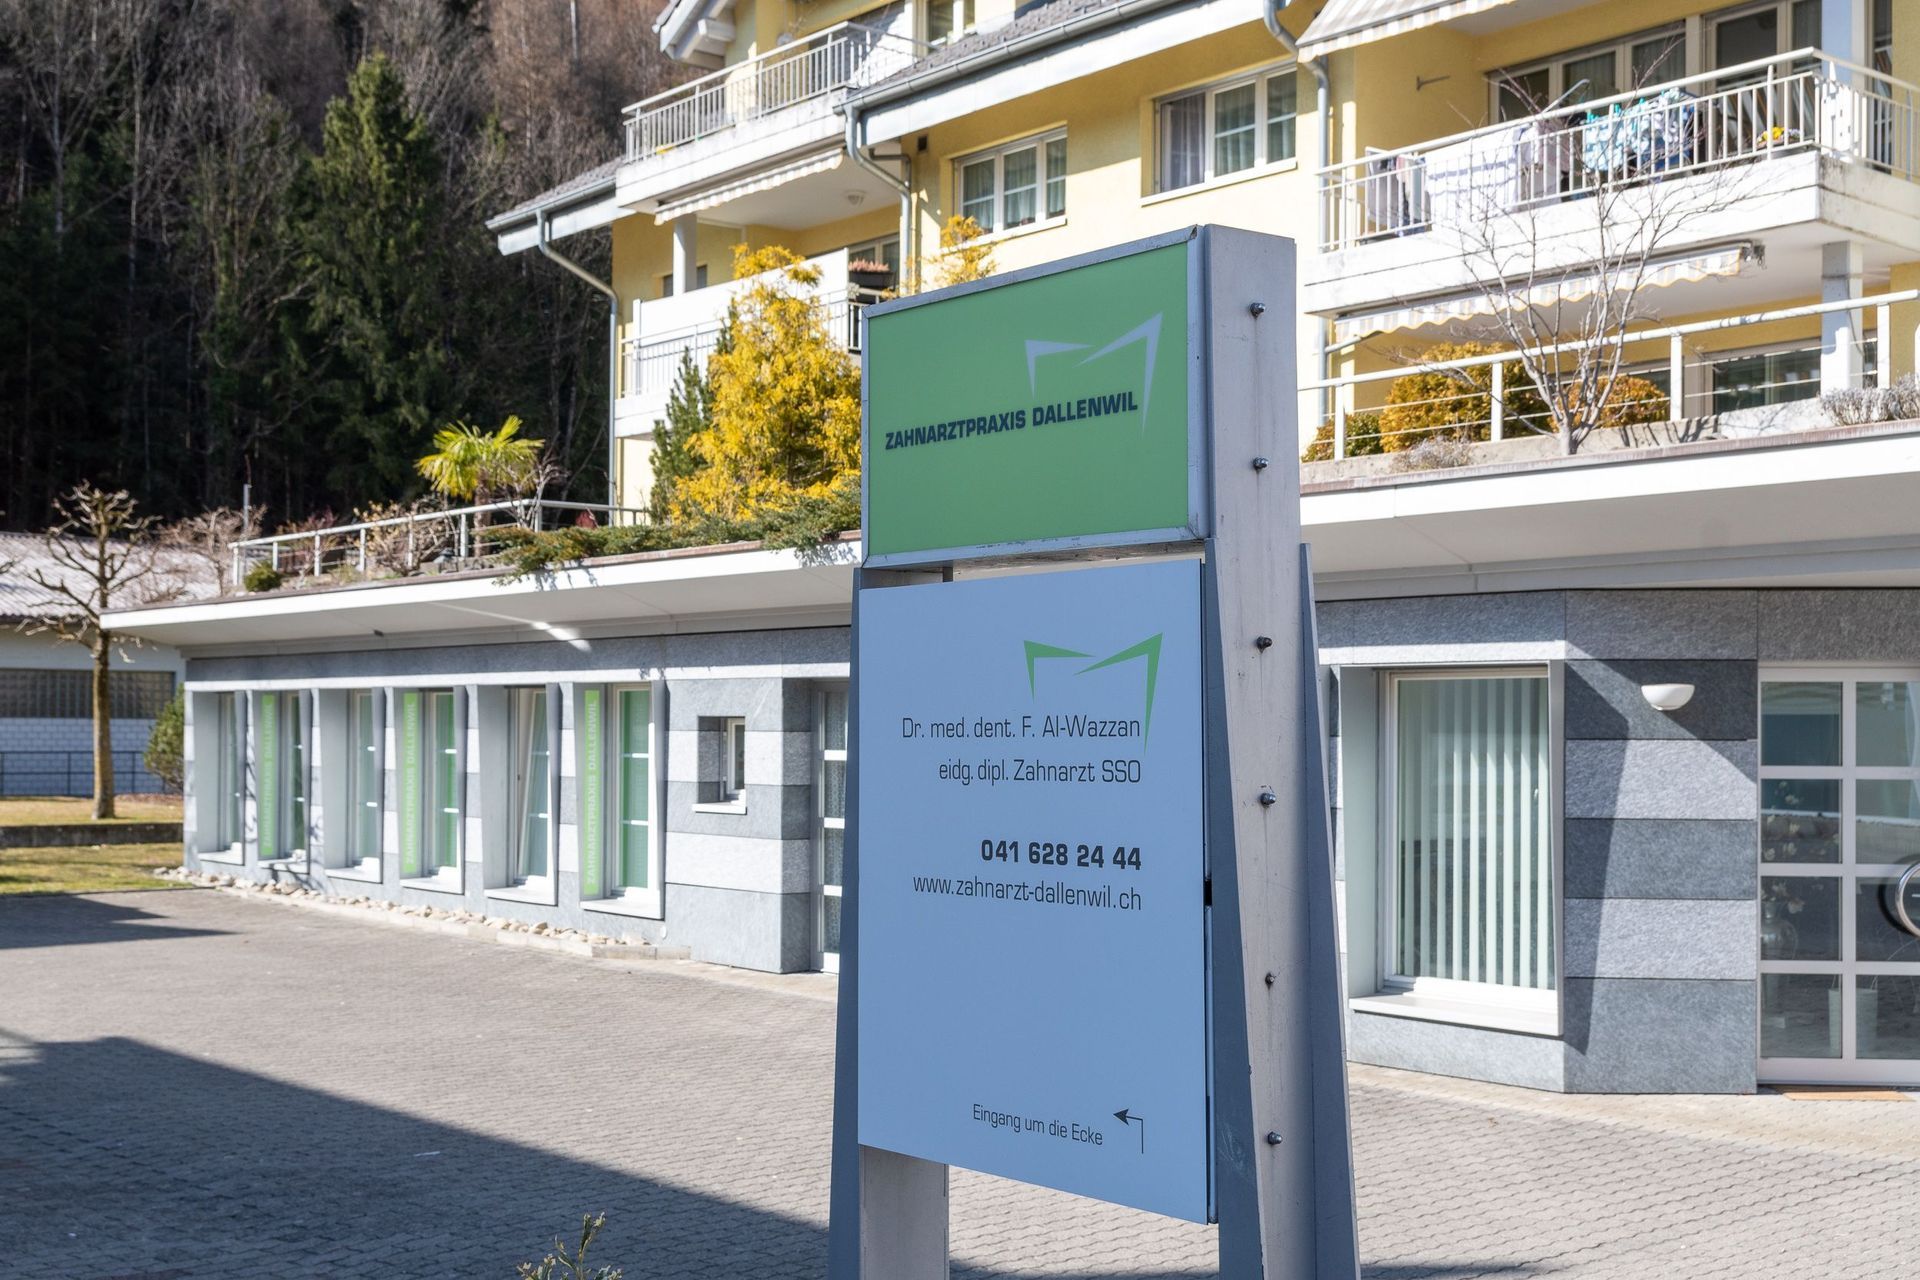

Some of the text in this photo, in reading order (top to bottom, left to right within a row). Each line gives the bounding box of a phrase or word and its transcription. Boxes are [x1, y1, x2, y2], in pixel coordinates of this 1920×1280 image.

[885, 391, 1139, 450] ZAHNARZTPRAXIS DALLENWIL
[588, 702, 597, 770] DALLENWIL
[902, 715, 1141, 738] Dr. med. dent. F. Al-Wazzan
[939, 759, 1141, 786] eidg. dipl. Zahnarzt SSO
[981, 839, 1141, 871] 041 628 24 44
[913, 876, 1142, 910] www.zahnarzt-dallenwil.ch
[973, 1103, 1103, 1146] Eingang um die Ecke
